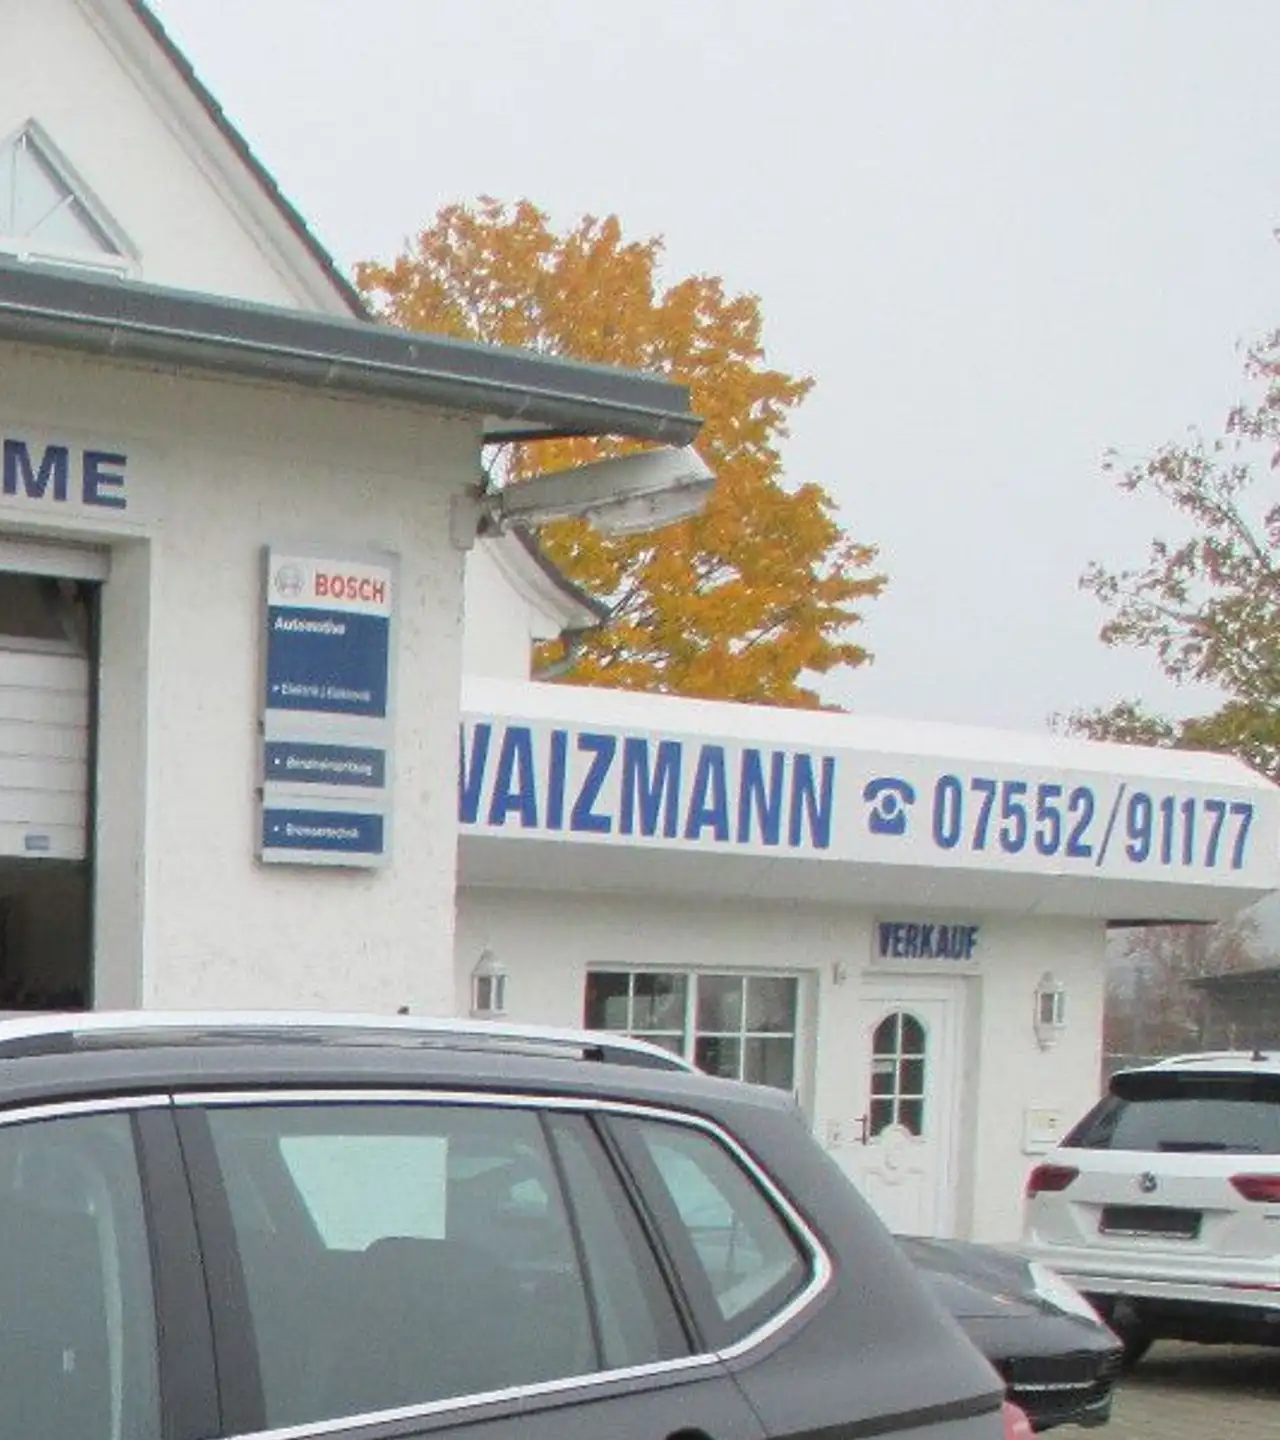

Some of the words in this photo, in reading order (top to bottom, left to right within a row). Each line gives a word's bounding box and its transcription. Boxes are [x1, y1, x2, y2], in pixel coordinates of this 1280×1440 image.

[313, 573, 385, 603] BOSCH
[932, 774, 1254, 870] 07552/91177
[878, 922, 979, 961] VERKAUF
